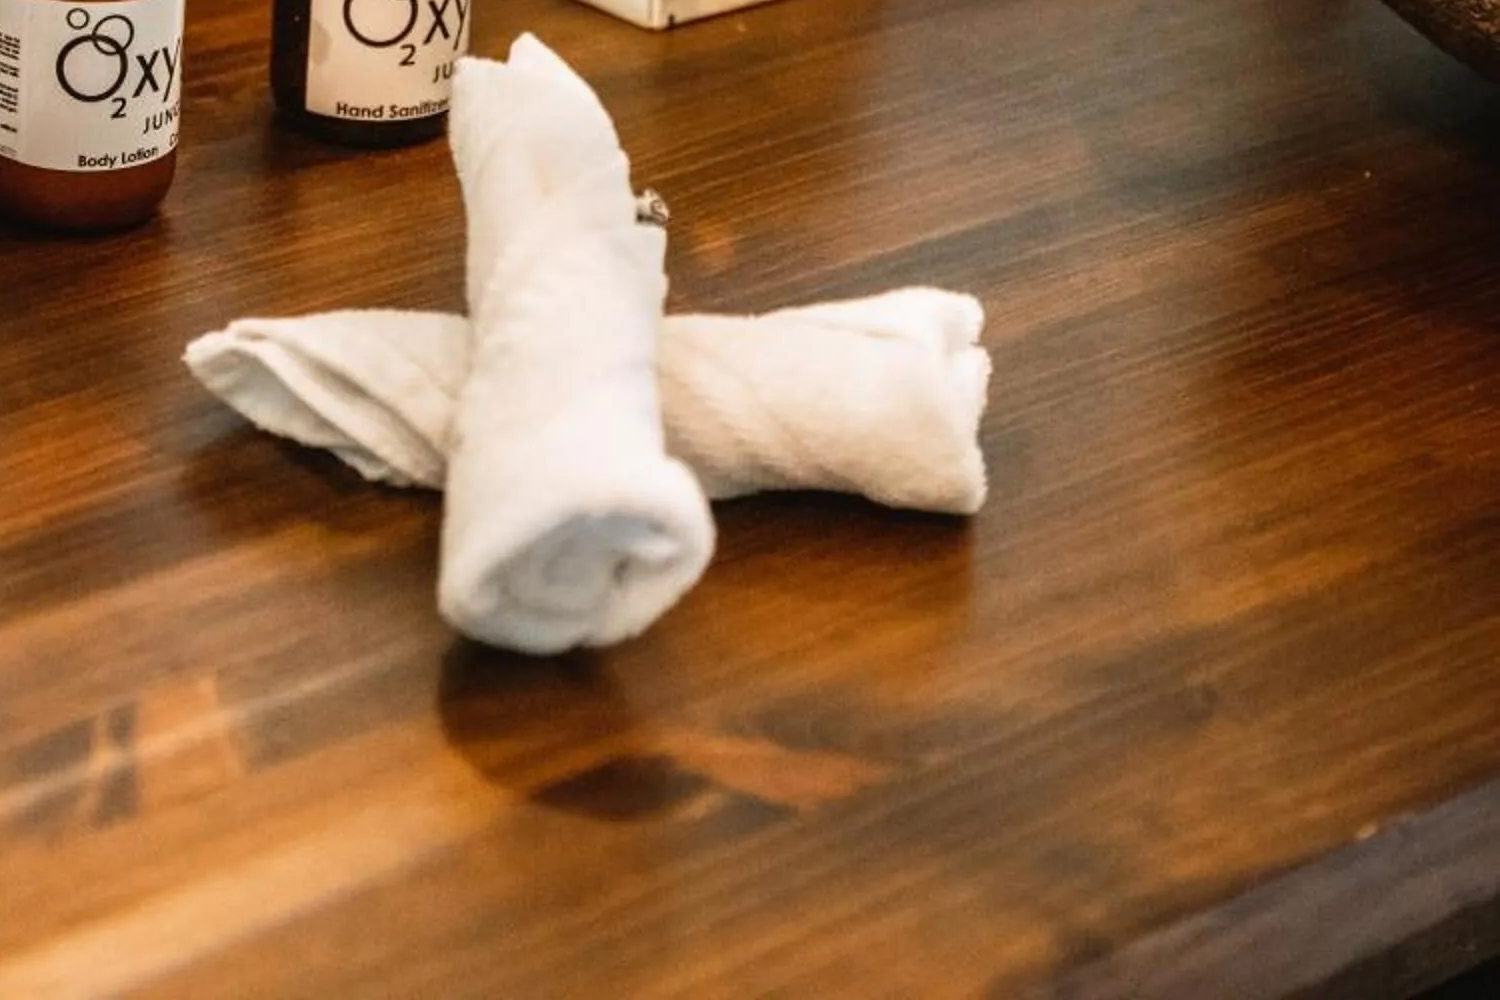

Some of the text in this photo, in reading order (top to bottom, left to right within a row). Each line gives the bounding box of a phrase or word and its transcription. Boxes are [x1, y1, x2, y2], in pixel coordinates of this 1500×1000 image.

[336, 101, 384, 119] Hand
[77, 146, 159, 170] Body Lotion
